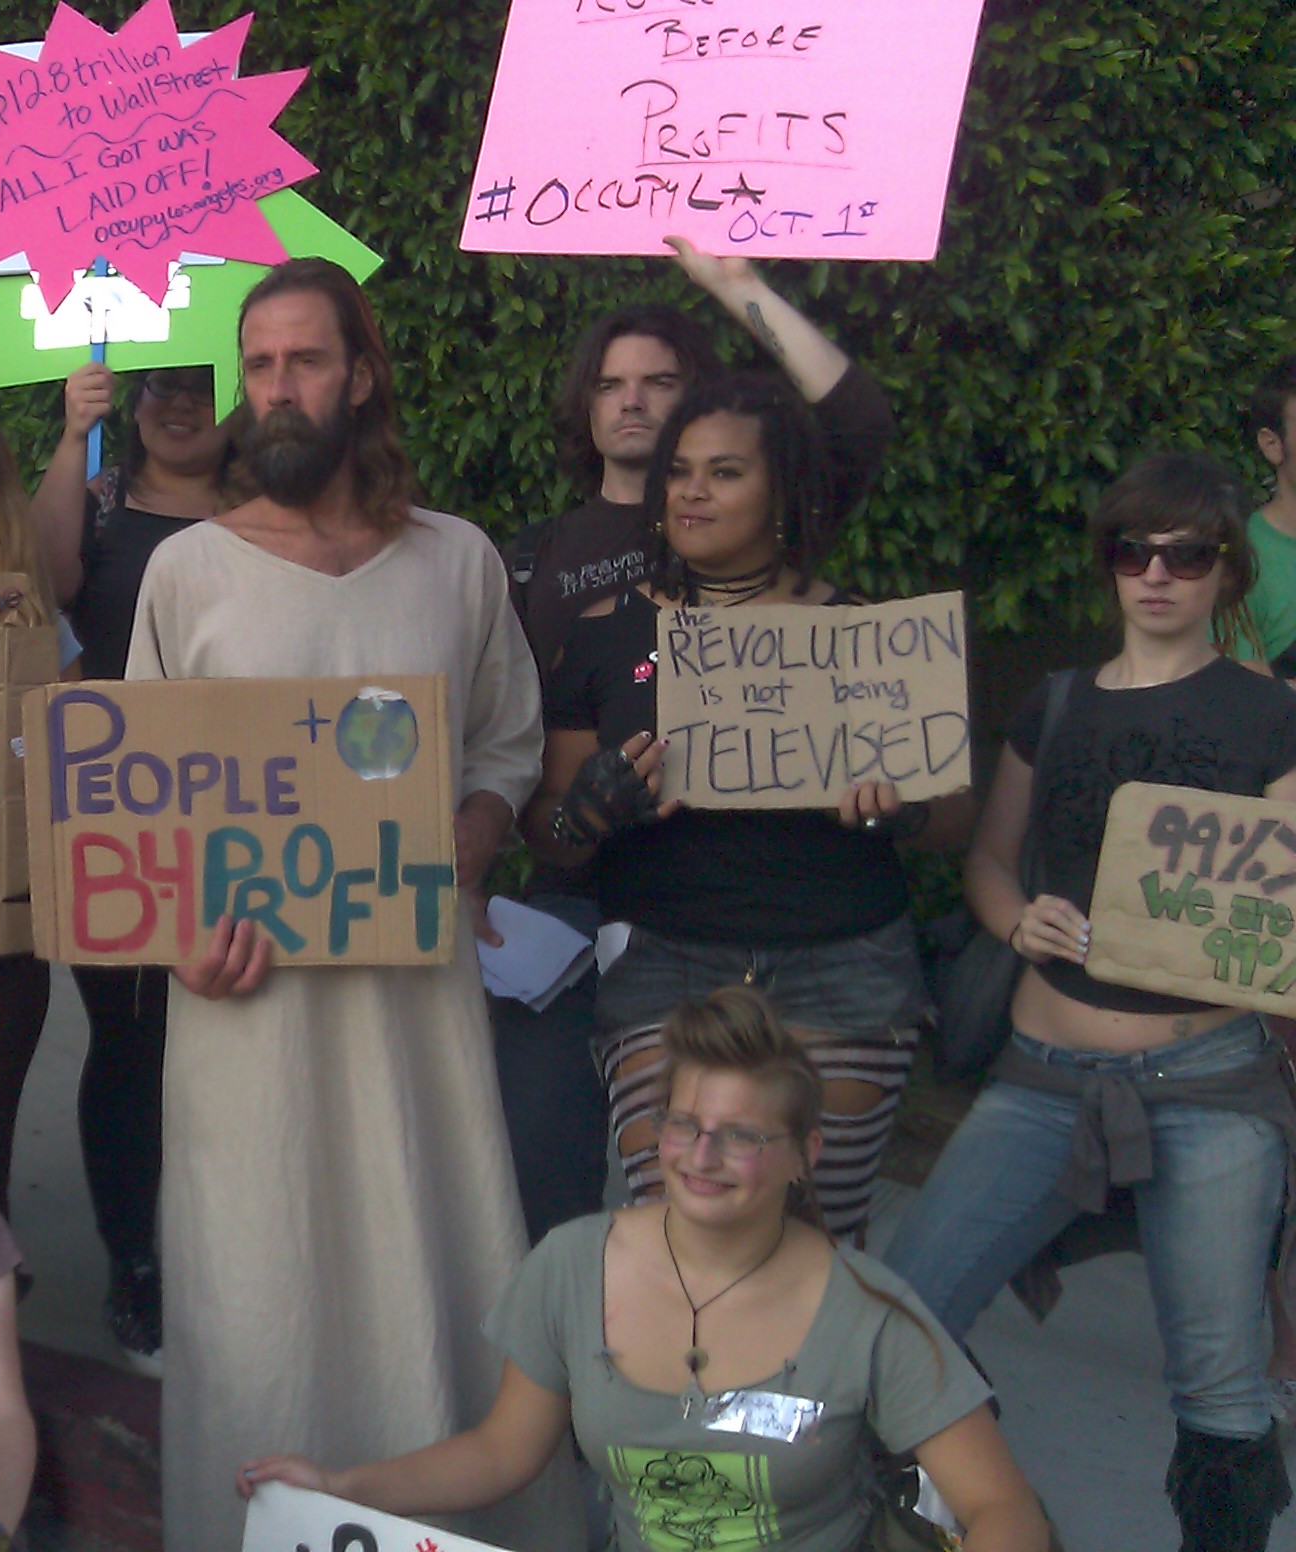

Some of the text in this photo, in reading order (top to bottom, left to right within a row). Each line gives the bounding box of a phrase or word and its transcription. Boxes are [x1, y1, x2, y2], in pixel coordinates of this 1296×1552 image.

[645, 19, 821, 58] BEFORE
[58, 102, 91, 129] to
[621, 80, 847, 164] PROFITS
[0, 171, 59, 212] ALL
[64, 153, 88, 185] I
[57, 148, 212, 232] LAID OFF!
[668, 610, 961, 677] REVOLUTION
[670, 605, 711, 627] the
[699, 675, 908, 710] is not being
[48, 689, 300, 824] PEOPLE
[667, 711, 970, 794] TELEVISED
[71, 820, 453, 958] B4 PROFIT
[1139, 870, 1294, 937] We are
